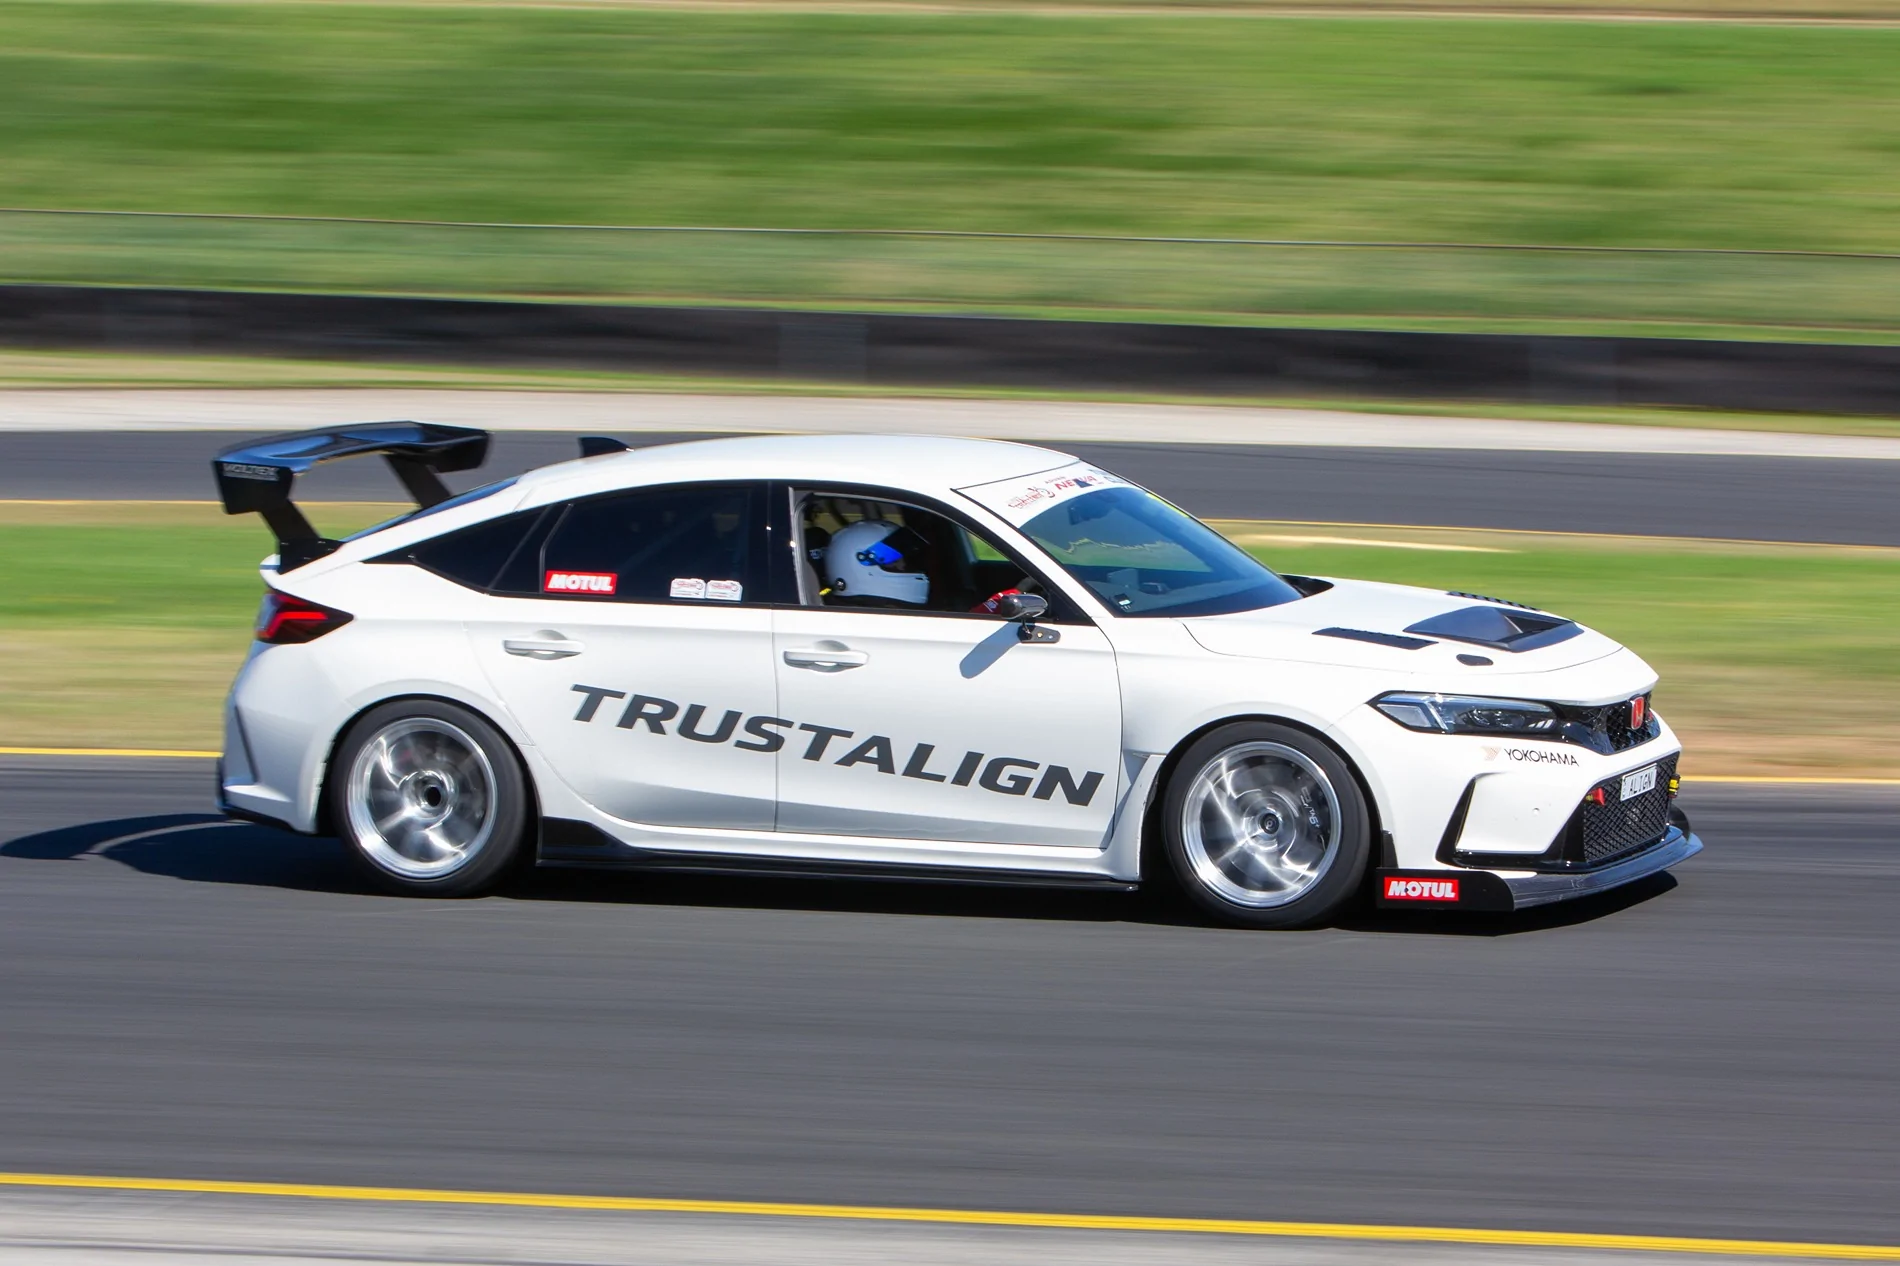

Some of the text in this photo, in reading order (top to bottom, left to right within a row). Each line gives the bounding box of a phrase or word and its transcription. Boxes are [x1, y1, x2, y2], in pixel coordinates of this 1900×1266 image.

[548, 573, 613, 591] MOTUL
[570, 684, 1104, 807] TRUSTALIGN
[1504, 748, 1580, 767] YOKOHAMA
[1388, 881, 1456, 898] MOTUL
